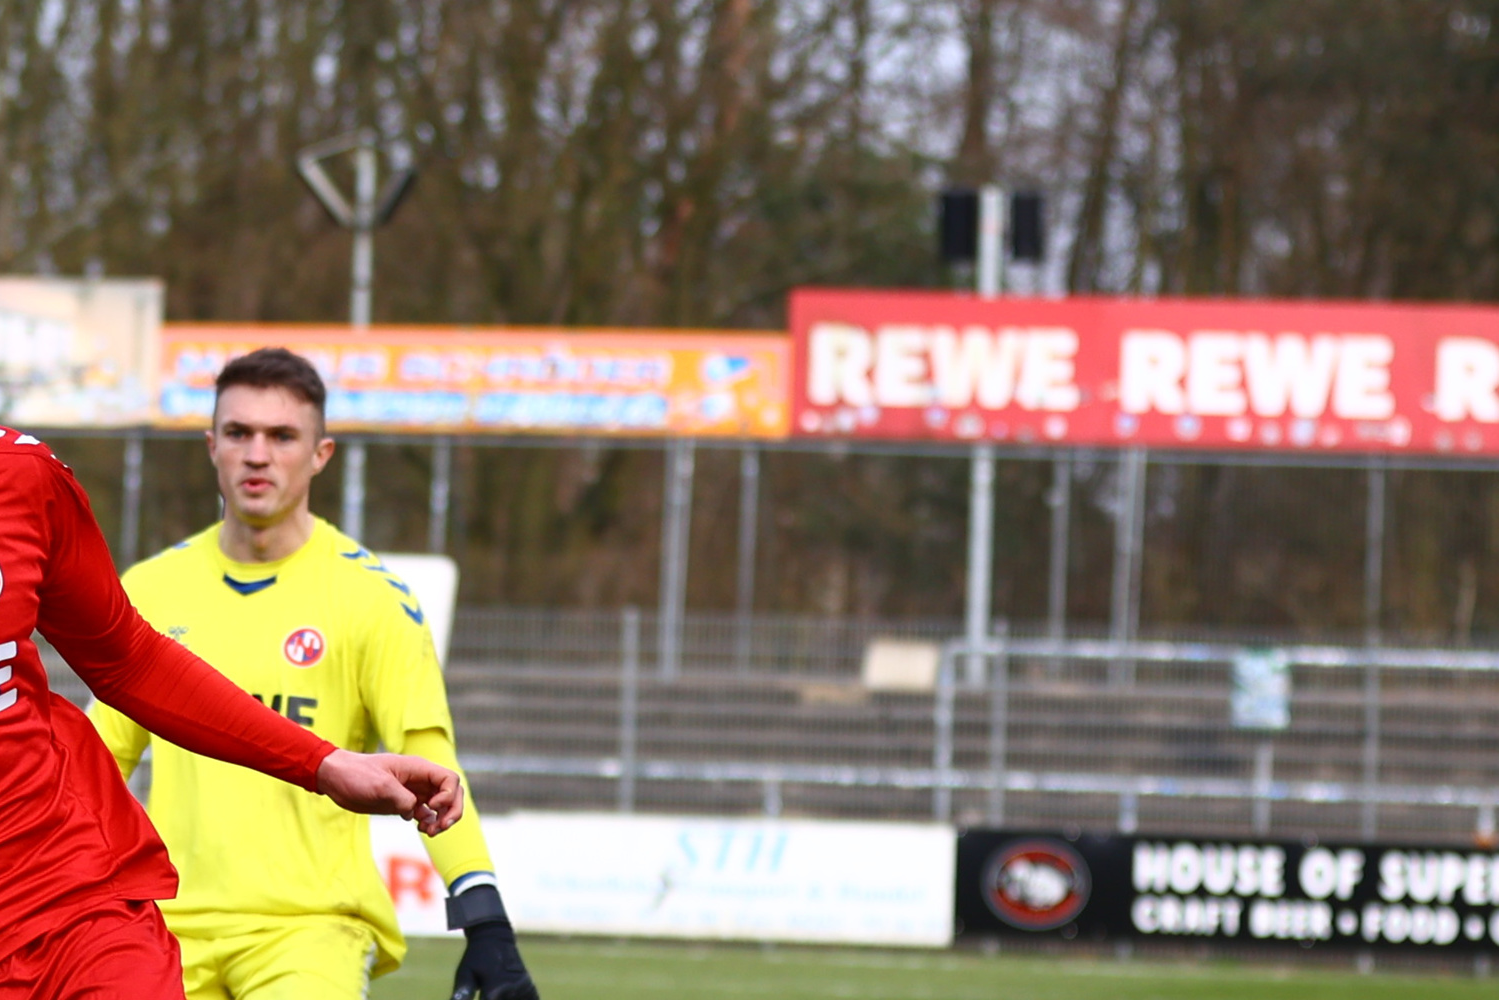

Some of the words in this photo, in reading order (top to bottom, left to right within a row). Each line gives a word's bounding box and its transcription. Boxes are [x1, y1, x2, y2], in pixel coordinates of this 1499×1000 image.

[809, 323, 1079, 408] REWE
[1121, 330, 1396, 418] REWE
[1132, 843, 1286, 897] HOUSE
[1299, 848, 1365, 900] OF
[1131, 894, 1243, 936] CRAFT
[1249, 900, 1333, 940] BEER
[1361, 902, 1460, 945] FOOD
